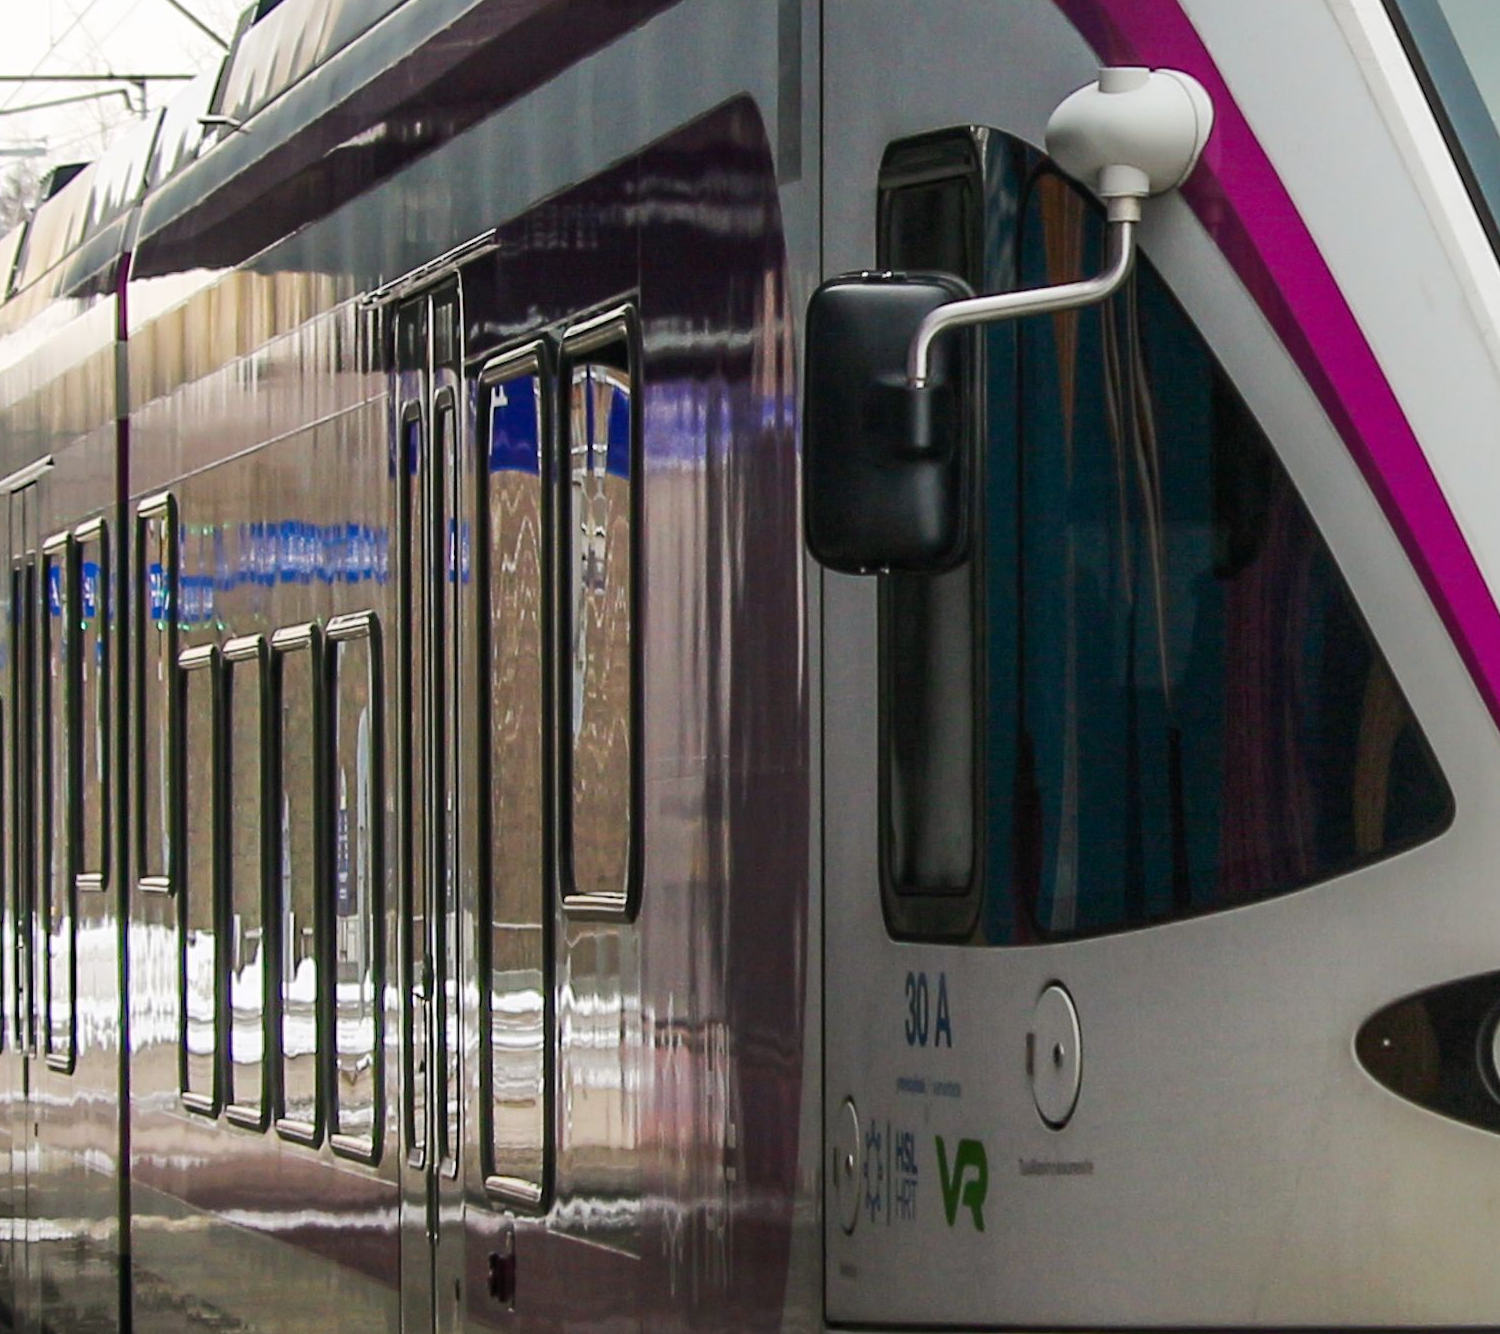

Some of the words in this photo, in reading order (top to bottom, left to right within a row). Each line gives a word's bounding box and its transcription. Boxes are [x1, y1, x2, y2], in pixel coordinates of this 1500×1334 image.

[905, 970, 929, 1047] 30
[935, 971, 952, 1048] A
[895, 1130, 918, 1175] HSL
[933, 1133, 989, 1233] VR
